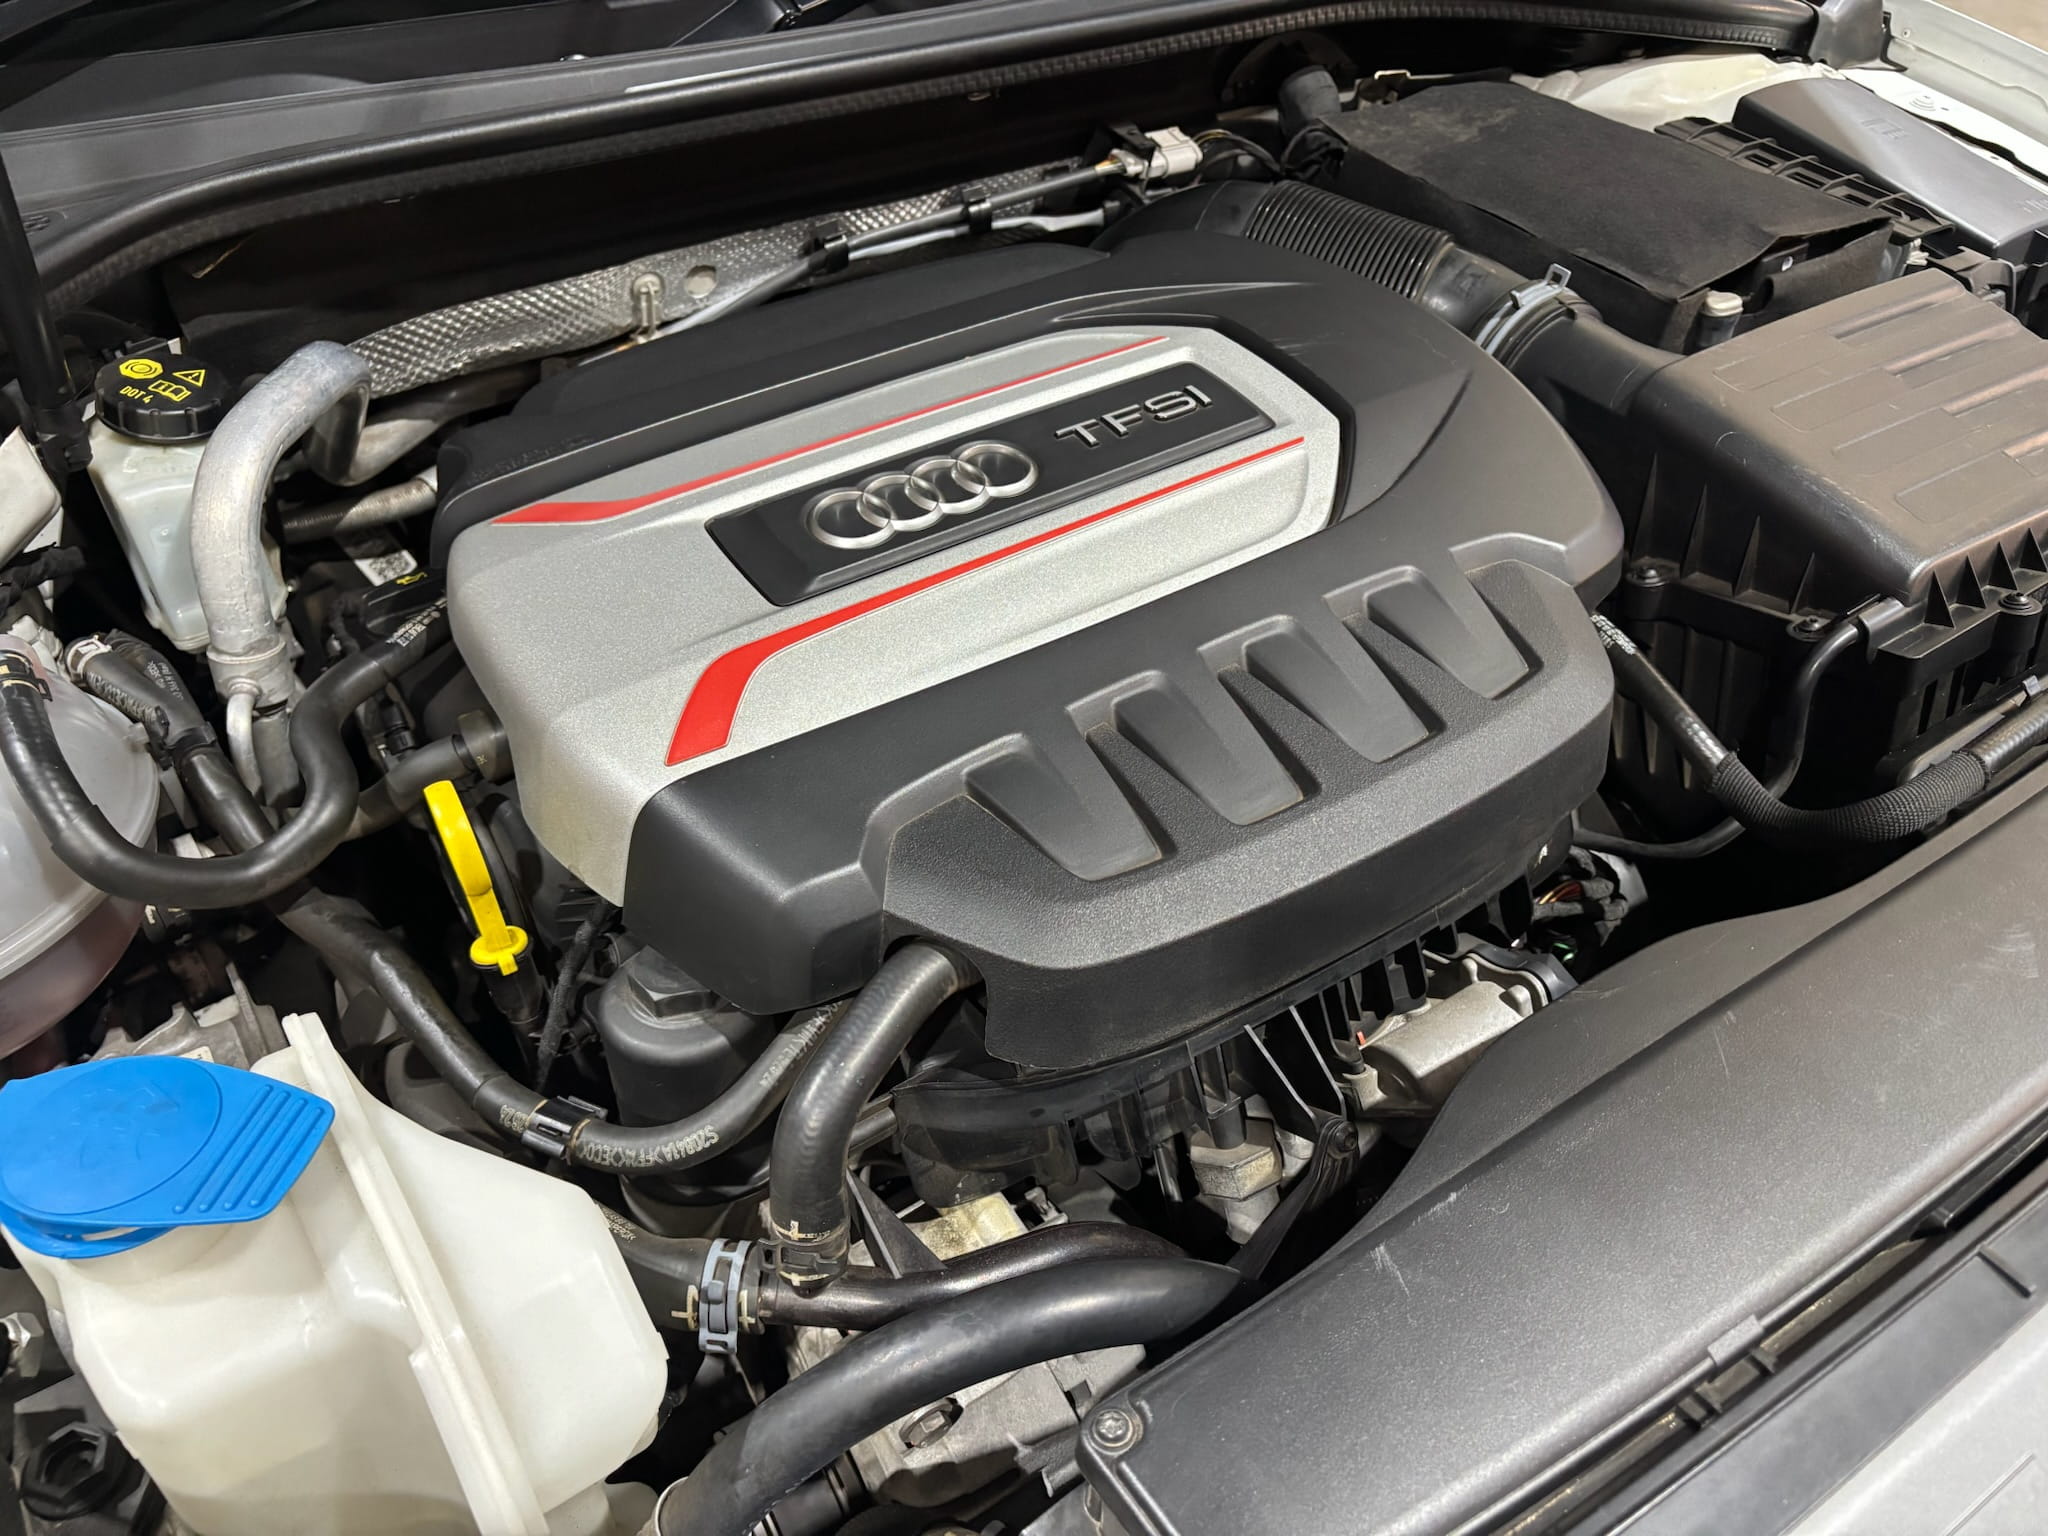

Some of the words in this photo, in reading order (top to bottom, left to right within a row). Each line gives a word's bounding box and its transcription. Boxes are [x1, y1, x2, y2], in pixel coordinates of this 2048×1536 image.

[119, 385, 147, 400] DOT
[142, 394, 154, 405] 4
[1054, 384, 1214, 448] TFSI
